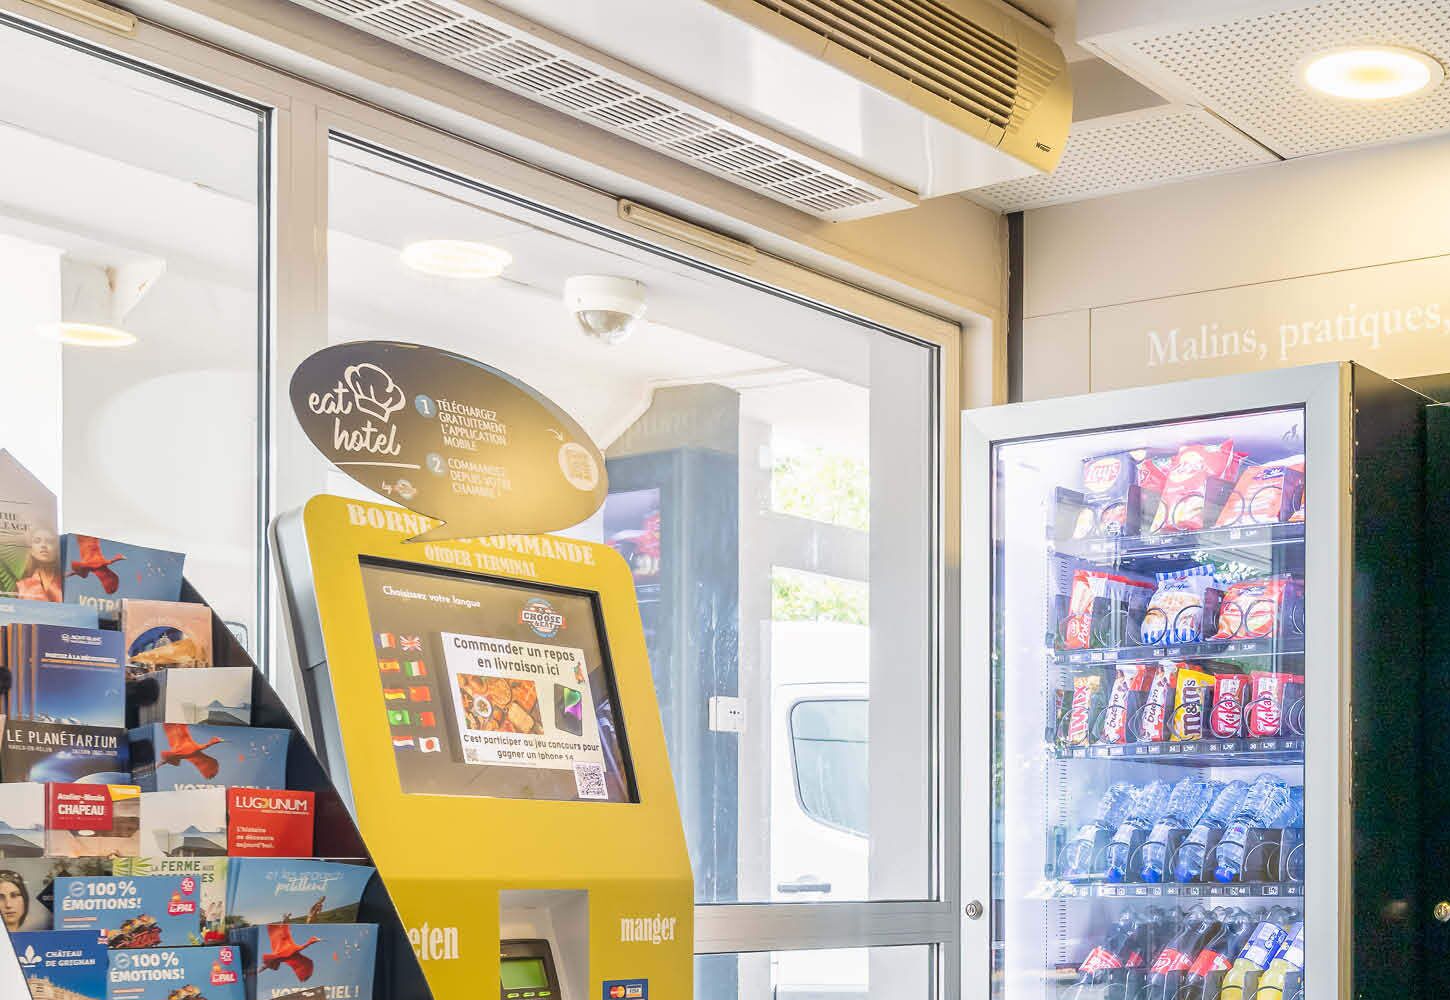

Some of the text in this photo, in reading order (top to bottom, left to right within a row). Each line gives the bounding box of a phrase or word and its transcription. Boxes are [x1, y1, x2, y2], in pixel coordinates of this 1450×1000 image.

[1146, 326, 1269, 369] Malins,
[309, 382, 352, 415] eat
[436, 399, 496, 421] TÉLÉCHARGEZ
[439, 412, 506, 434] GRATUITEMENT
[334, 417, 401, 456] hotel
[424, 545, 472, 567] ORDER
[382, 585, 428, 601] Choisissez
[429, 593, 450, 604] votre
[523, 612, 561, 624] CHOOSE
[454, 637, 575, 662] Commander un repas
[477, 657, 560, 676] en livraison ici
[6, 729, 118, 749] LE PLANÉTARIUM
[463, 734, 482, 743] C'est
[484, 736, 521, 747] participer
[535, 739, 547, 749] jeu
[548, 742, 581, 750] concours
[583, 744, 600, 752] pour
[497, 749, 524, 759] gagner
[58, 804, 104, 816] CHAPEAU
[161, 860, 201, 872] FERME
[62, 897, 142, 911] ÉMOTIONS!
[620, 914, 676, 945] manger
[45, 950, 82, 958] CHÂTEAU
[45, 959, 55, 967] DE
[110, 968, 185, 983] ÉMOTIONS!
